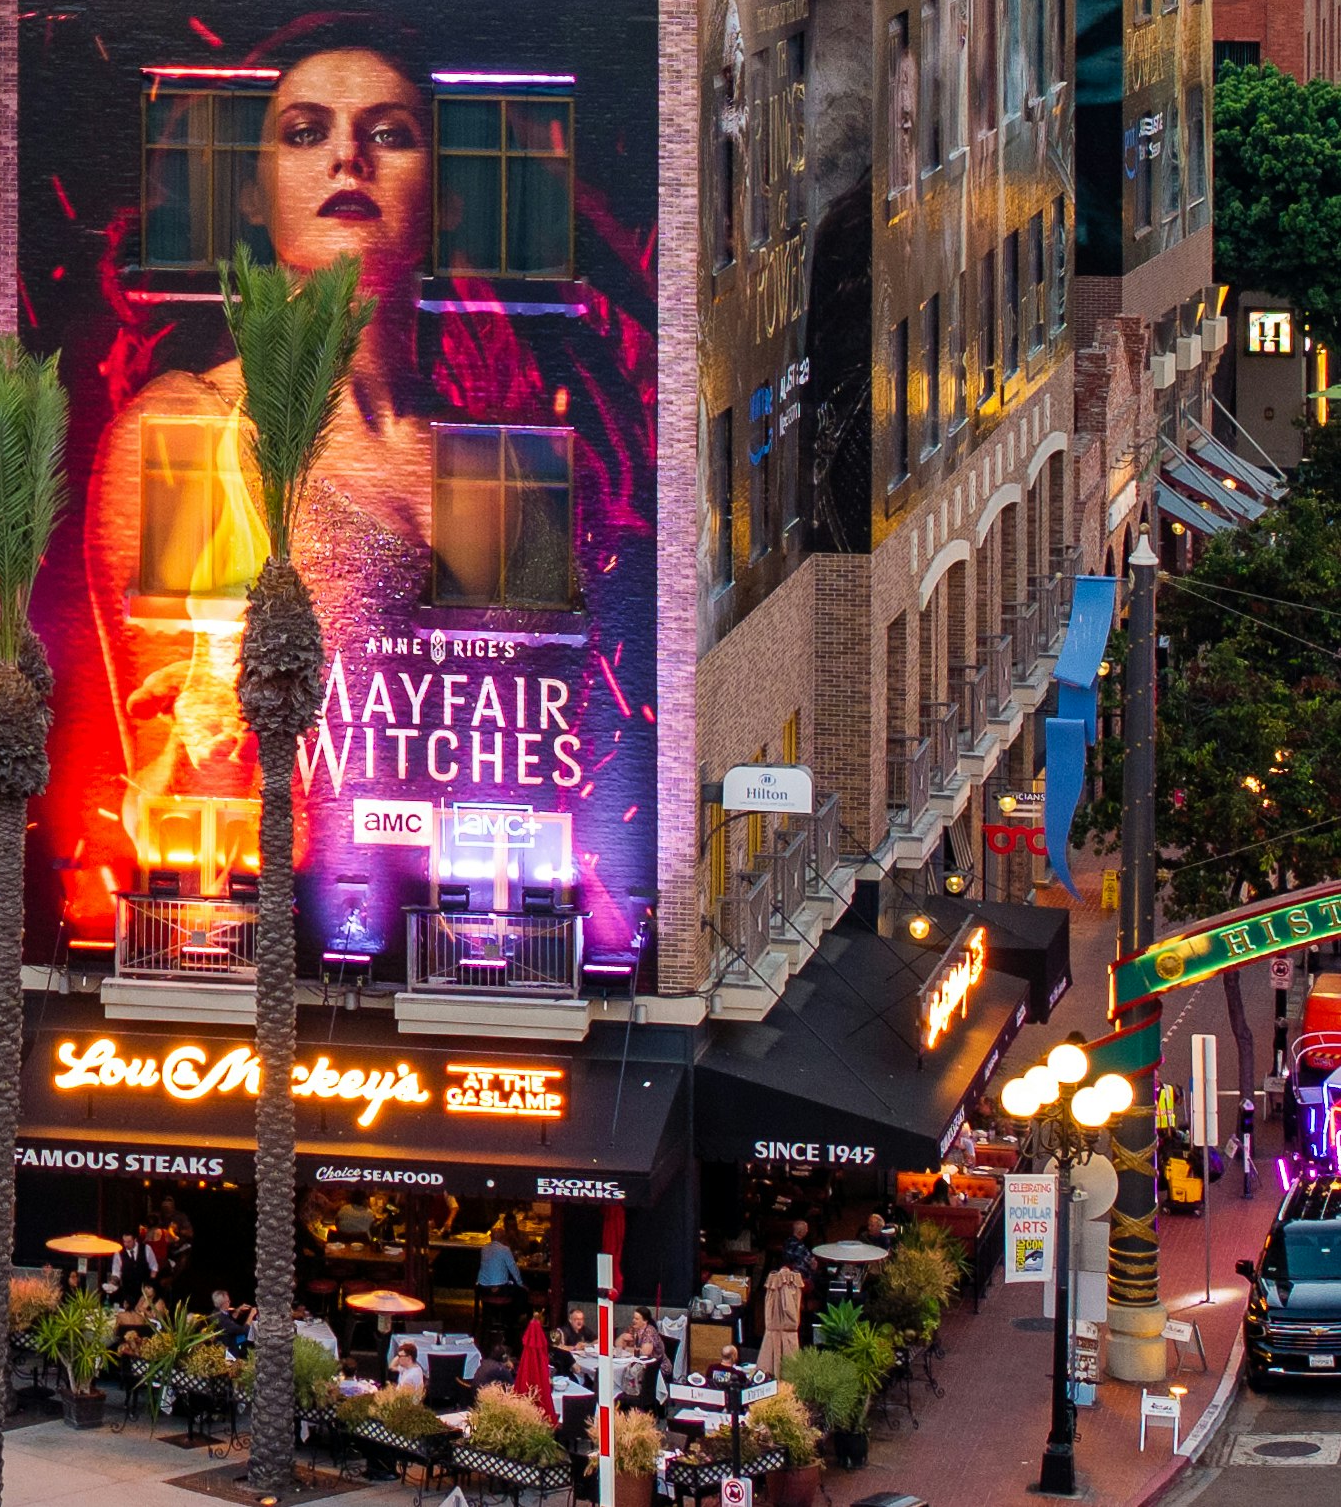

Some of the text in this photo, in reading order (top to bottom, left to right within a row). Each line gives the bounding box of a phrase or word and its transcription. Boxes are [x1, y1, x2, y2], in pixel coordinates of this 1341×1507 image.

[365, 637, 515, 658] ANNE RICE'S
[317, 649, 570, 730] MAYFAIR
[298, 721, 582, 798] WITCHES
[746, 787, 788, 800] Hilton
[1220, 899, 1341, 958] HIST
[54, 1039, 160, 1090] Lou
[199, 1046, 430, 1128] Mckey's
[463, 1073, 547, 1094] AT THE
[446, 1088, 563, 1111] GASLAMP
[754, 1140, 877, 1165] SINCE 1945
[14, 1147, 444, 1186] FAMOUS STEAKS Choice SEAFOOD
[537, 1178, 620, 1190] EXOTIC
[537, 1187, 627, 1200] DRINKS
[1009, 1182, 1052, 1193] CELEBRATING
[1022, 1195, 1039, 1205] THE
[1010, 1207, 1052, 1219] POPULAR
[1013, 1221, 1048, 1234] ARTS
[1025, 1239, 1044, 1250] CON
